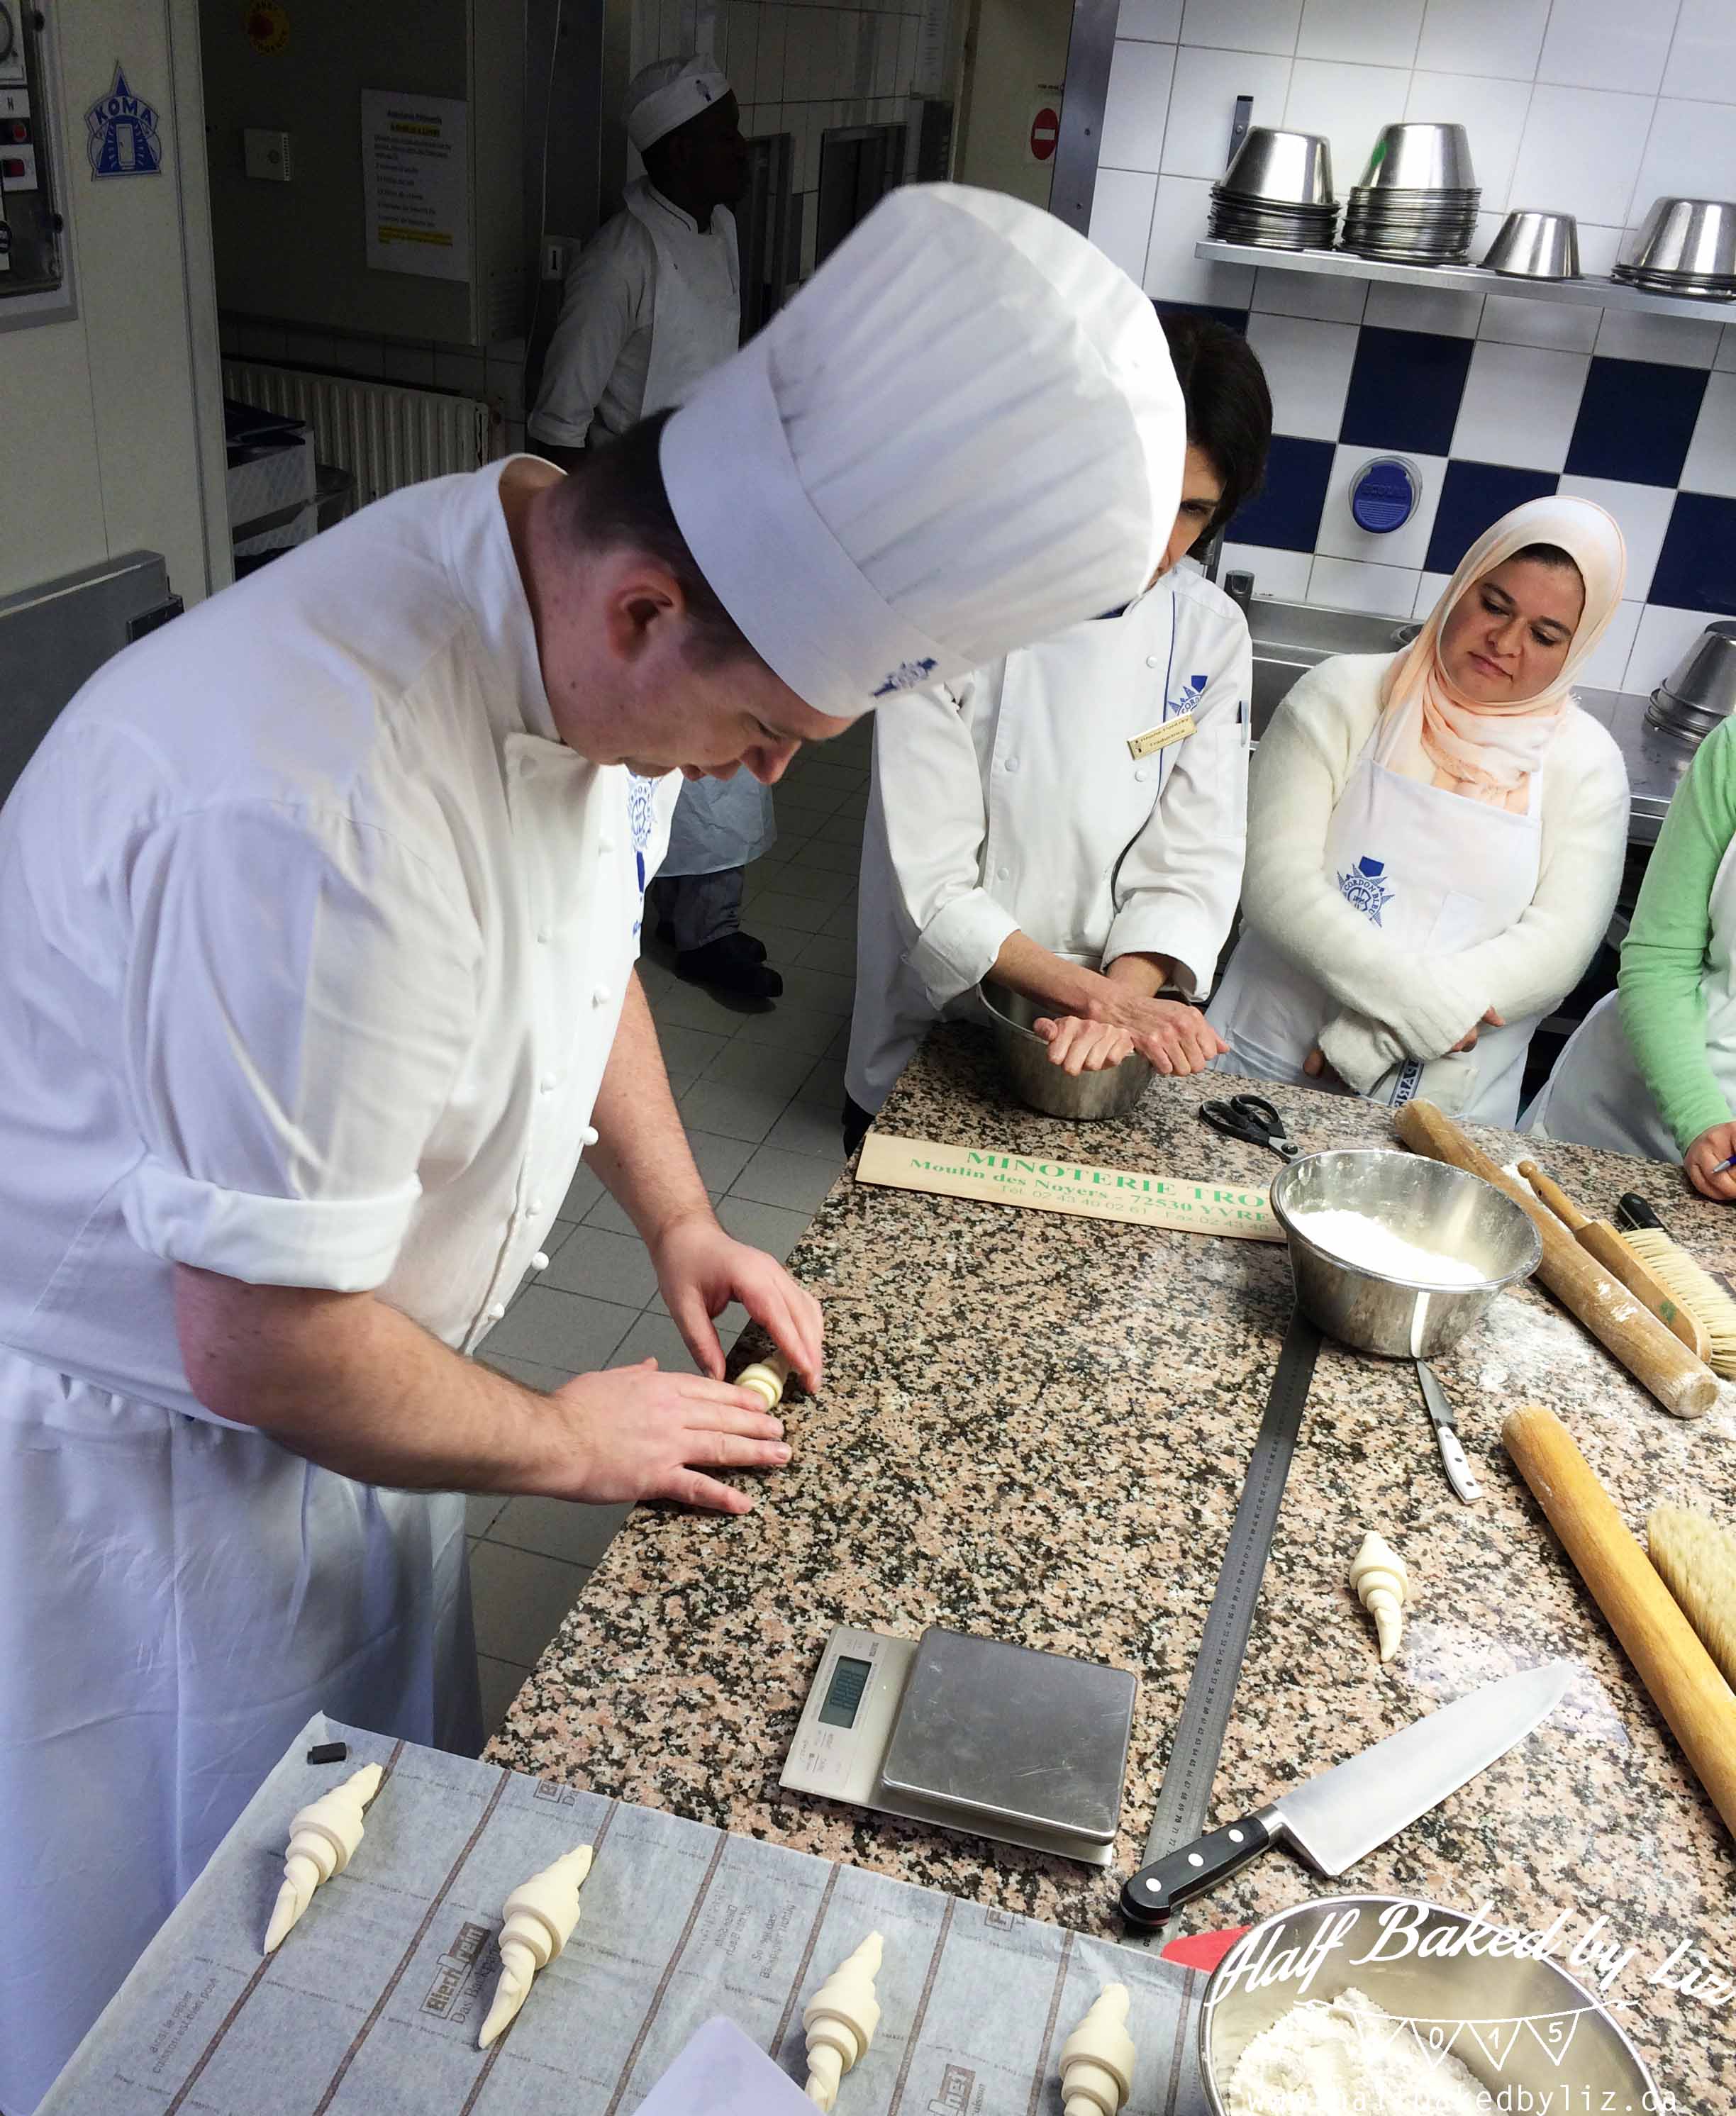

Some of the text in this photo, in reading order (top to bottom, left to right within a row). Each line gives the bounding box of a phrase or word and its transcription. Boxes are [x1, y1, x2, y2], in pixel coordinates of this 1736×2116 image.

[94, 96, 152, 126] KOMA
[1344, 879, 1376, 893] CORDON
[910, 1159, 985, 1179] Moulin
[993, 1173, 1027, 1186] des
[1035, 1179, 1108, 1200] Noyers
[1130, 1195, 1192, 1211] 72530
[967, 1152, 1268, 1207] MINOTERIE TRO
[1033, 1190, 1052, 1198] 02
[1105, 1201, 1124, 1210] 02
[450, 2001, 474, 2025] Das
[945, 2071, 967, 2105] net
